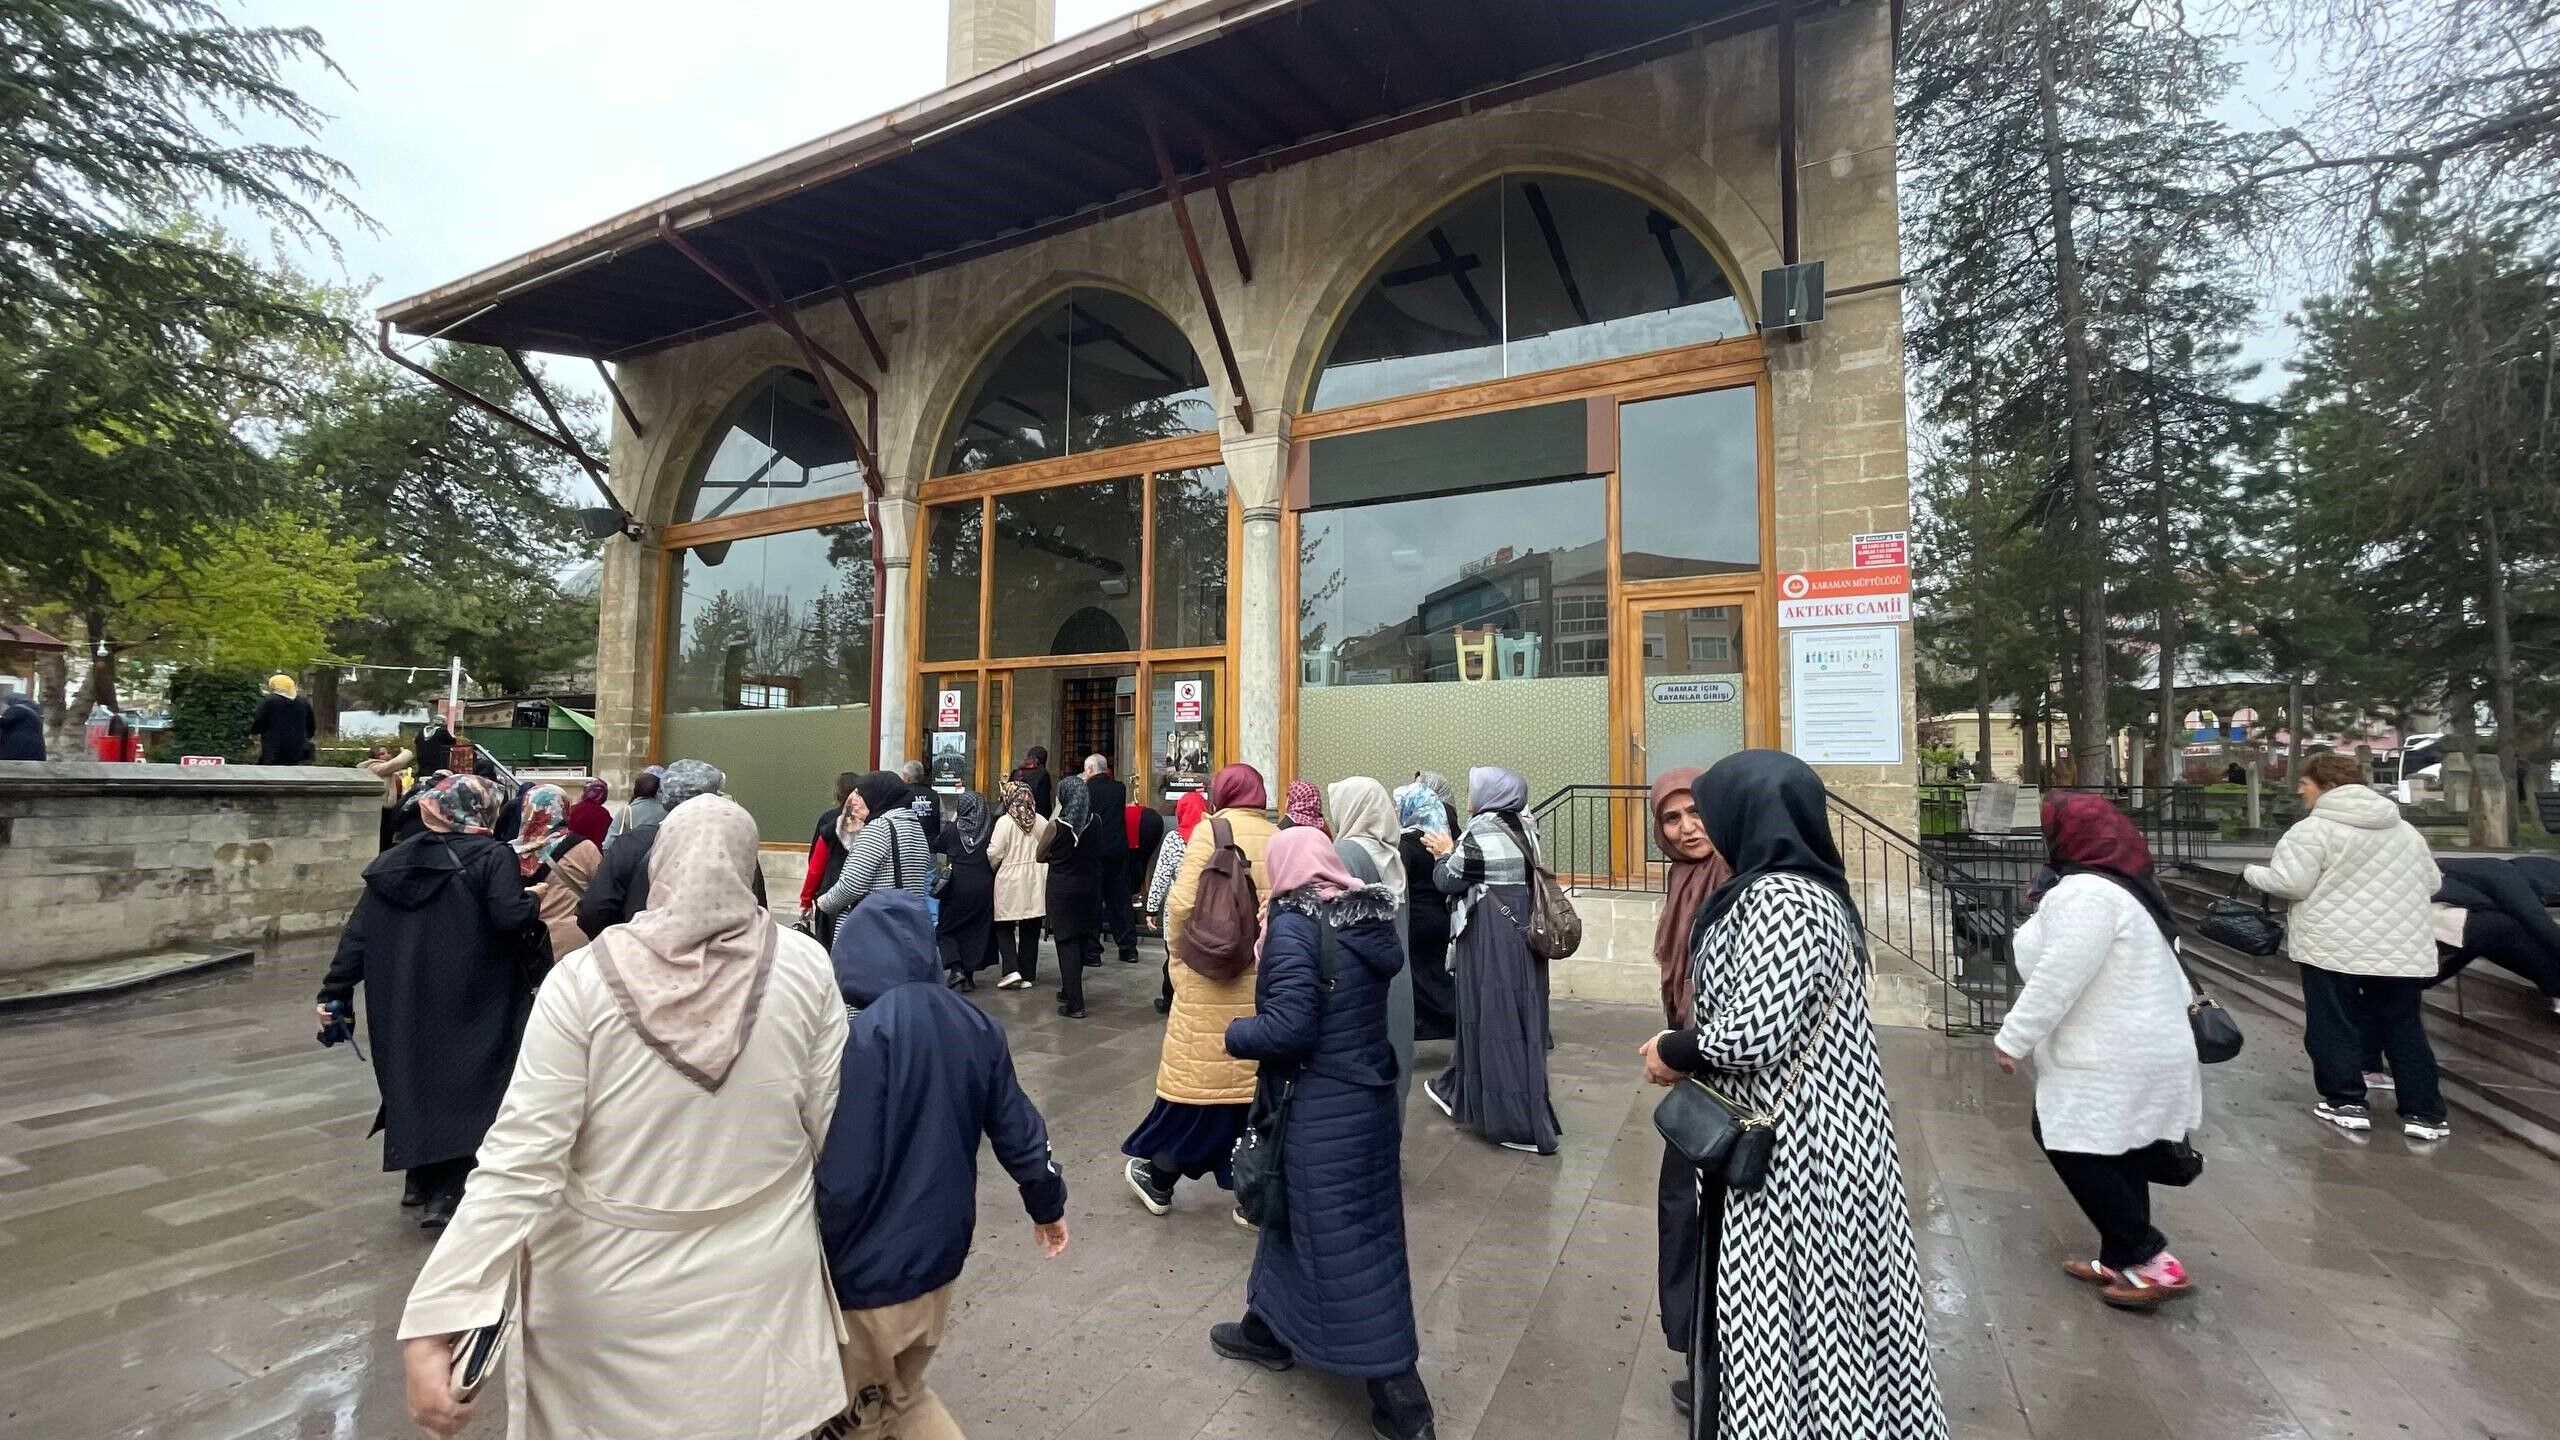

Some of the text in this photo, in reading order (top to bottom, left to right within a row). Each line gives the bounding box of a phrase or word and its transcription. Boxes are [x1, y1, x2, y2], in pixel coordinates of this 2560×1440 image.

[1811, 575, 1902, 590] KARAMAN MÜFTÜLÜĞÜ
[1785, 597, 1901, 618] AKTEKKE CAMİİ
